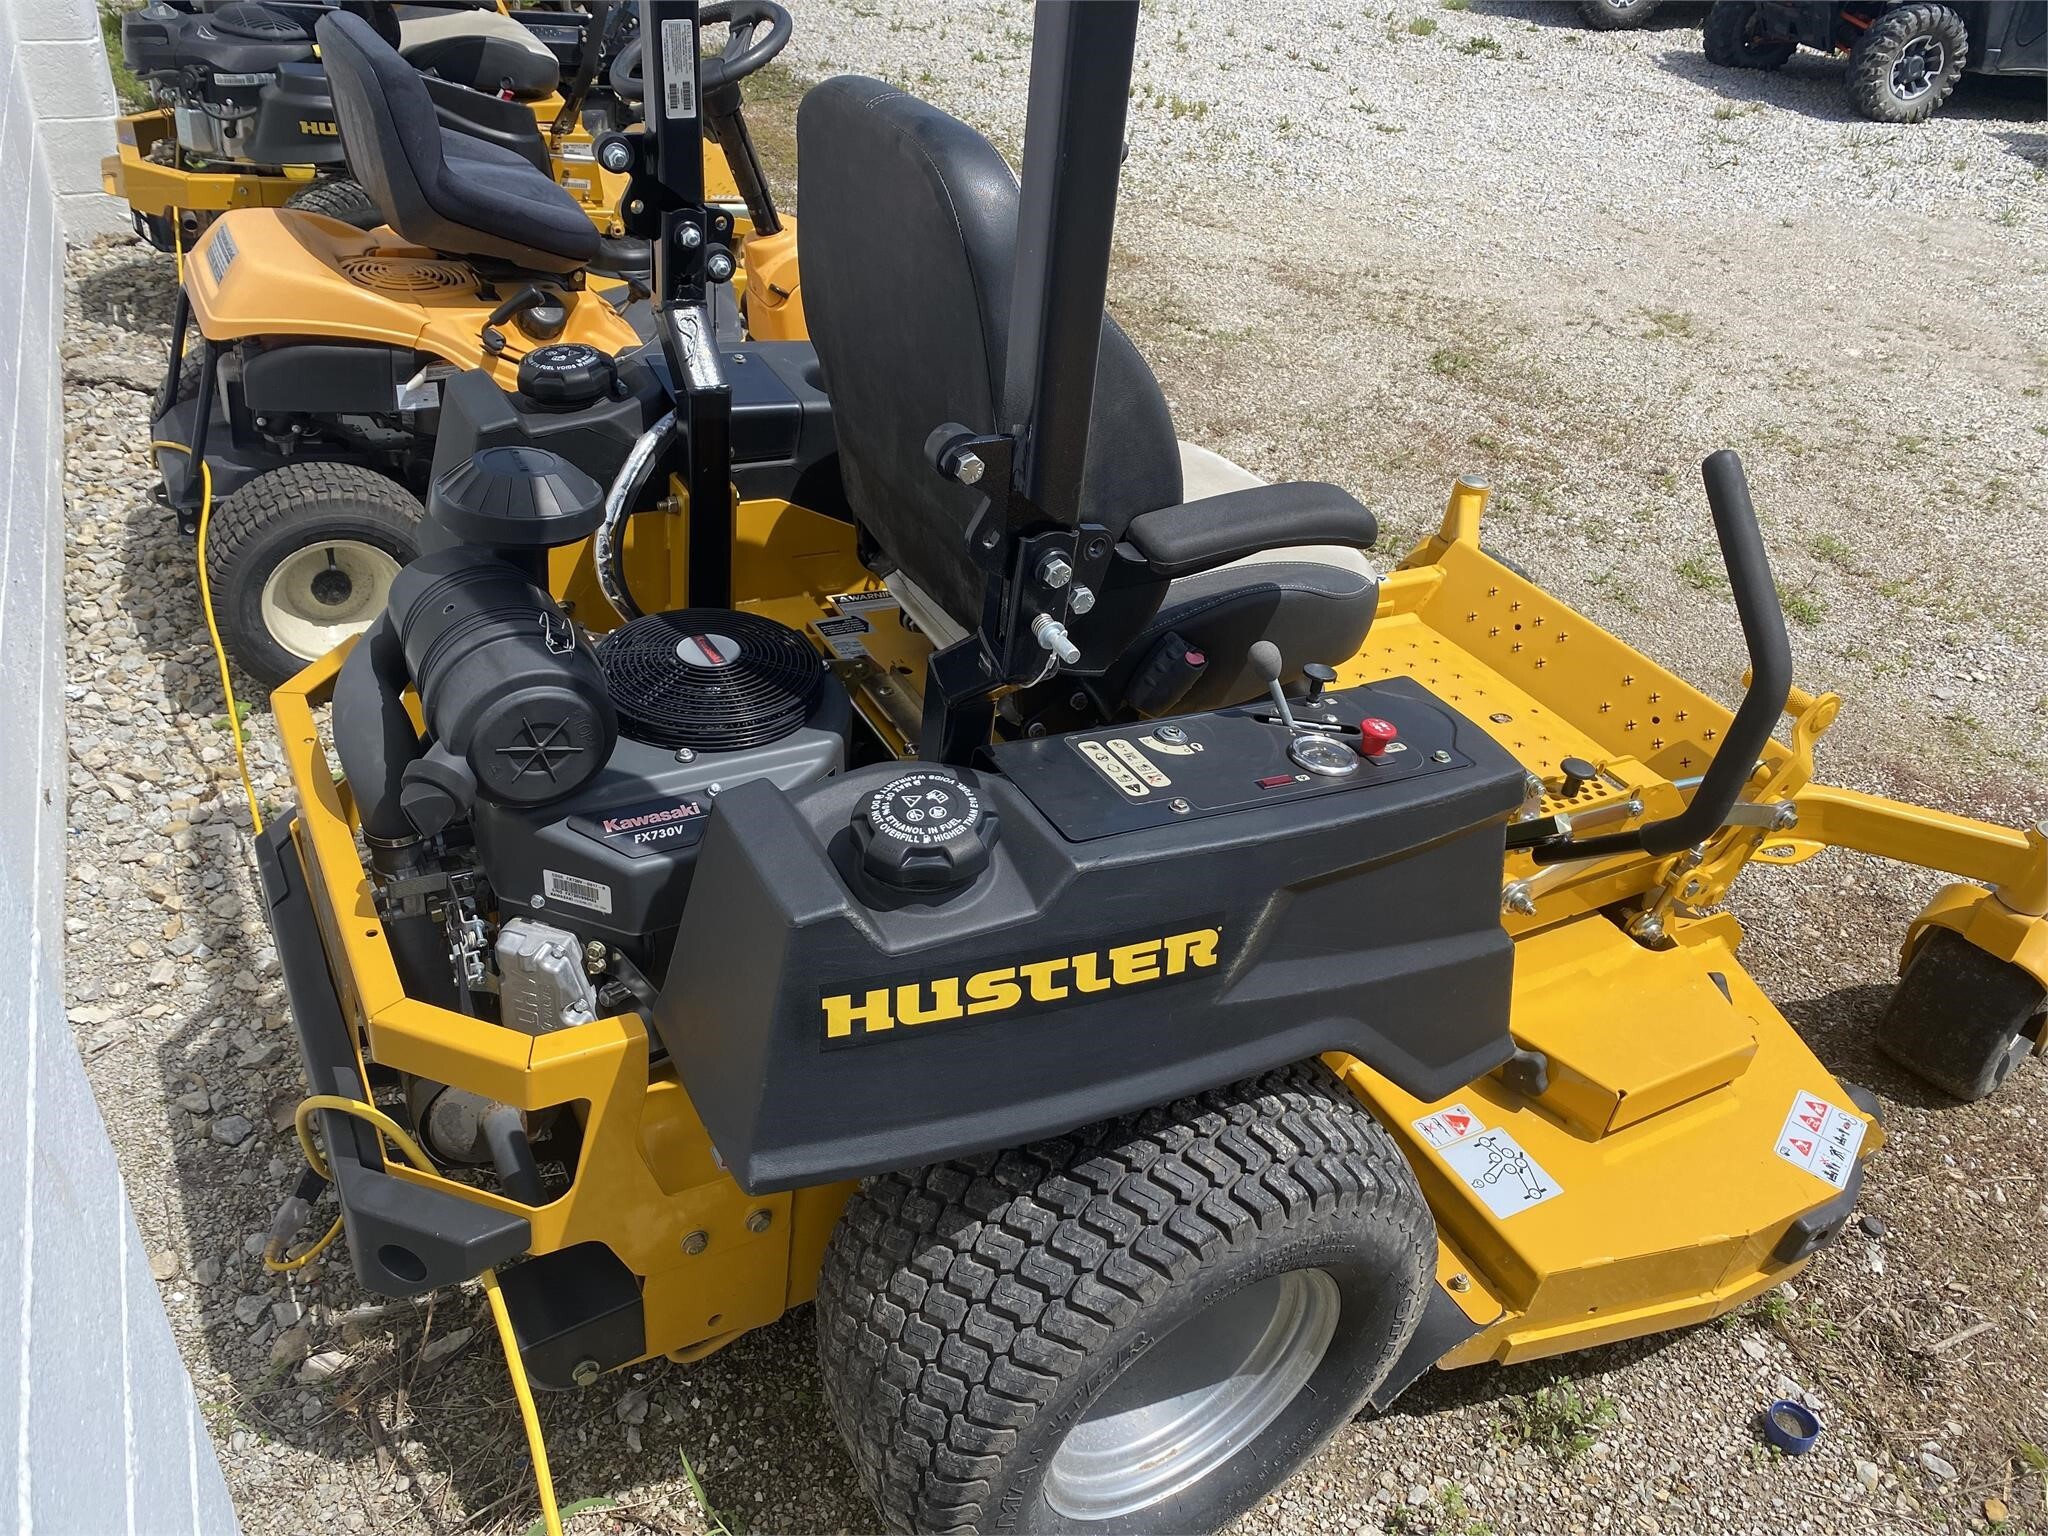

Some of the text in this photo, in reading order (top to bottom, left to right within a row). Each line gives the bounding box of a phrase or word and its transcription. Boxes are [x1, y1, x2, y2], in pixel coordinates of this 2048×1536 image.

[880, 774, 926, 795] WARRANTY
[928, 775, 955, 785] VOIDS
[956, 782, 974, 797] FUEL
[602, 801, 701, 833] Kawasaki
[871, 800, 920, 843] DO NOT OVERFILL
[885, 815, 925, 834] ETHANOL
[928, 826, 938, 834] IN
[940, 818, 962, 832] FUEL
[963, 808, 979, 826] THAN
[634, 824, 684, 844] FX730V
[933, 824, 967, 842] HIGHER
[821, 927, 1221, 1038] HUSTLER
